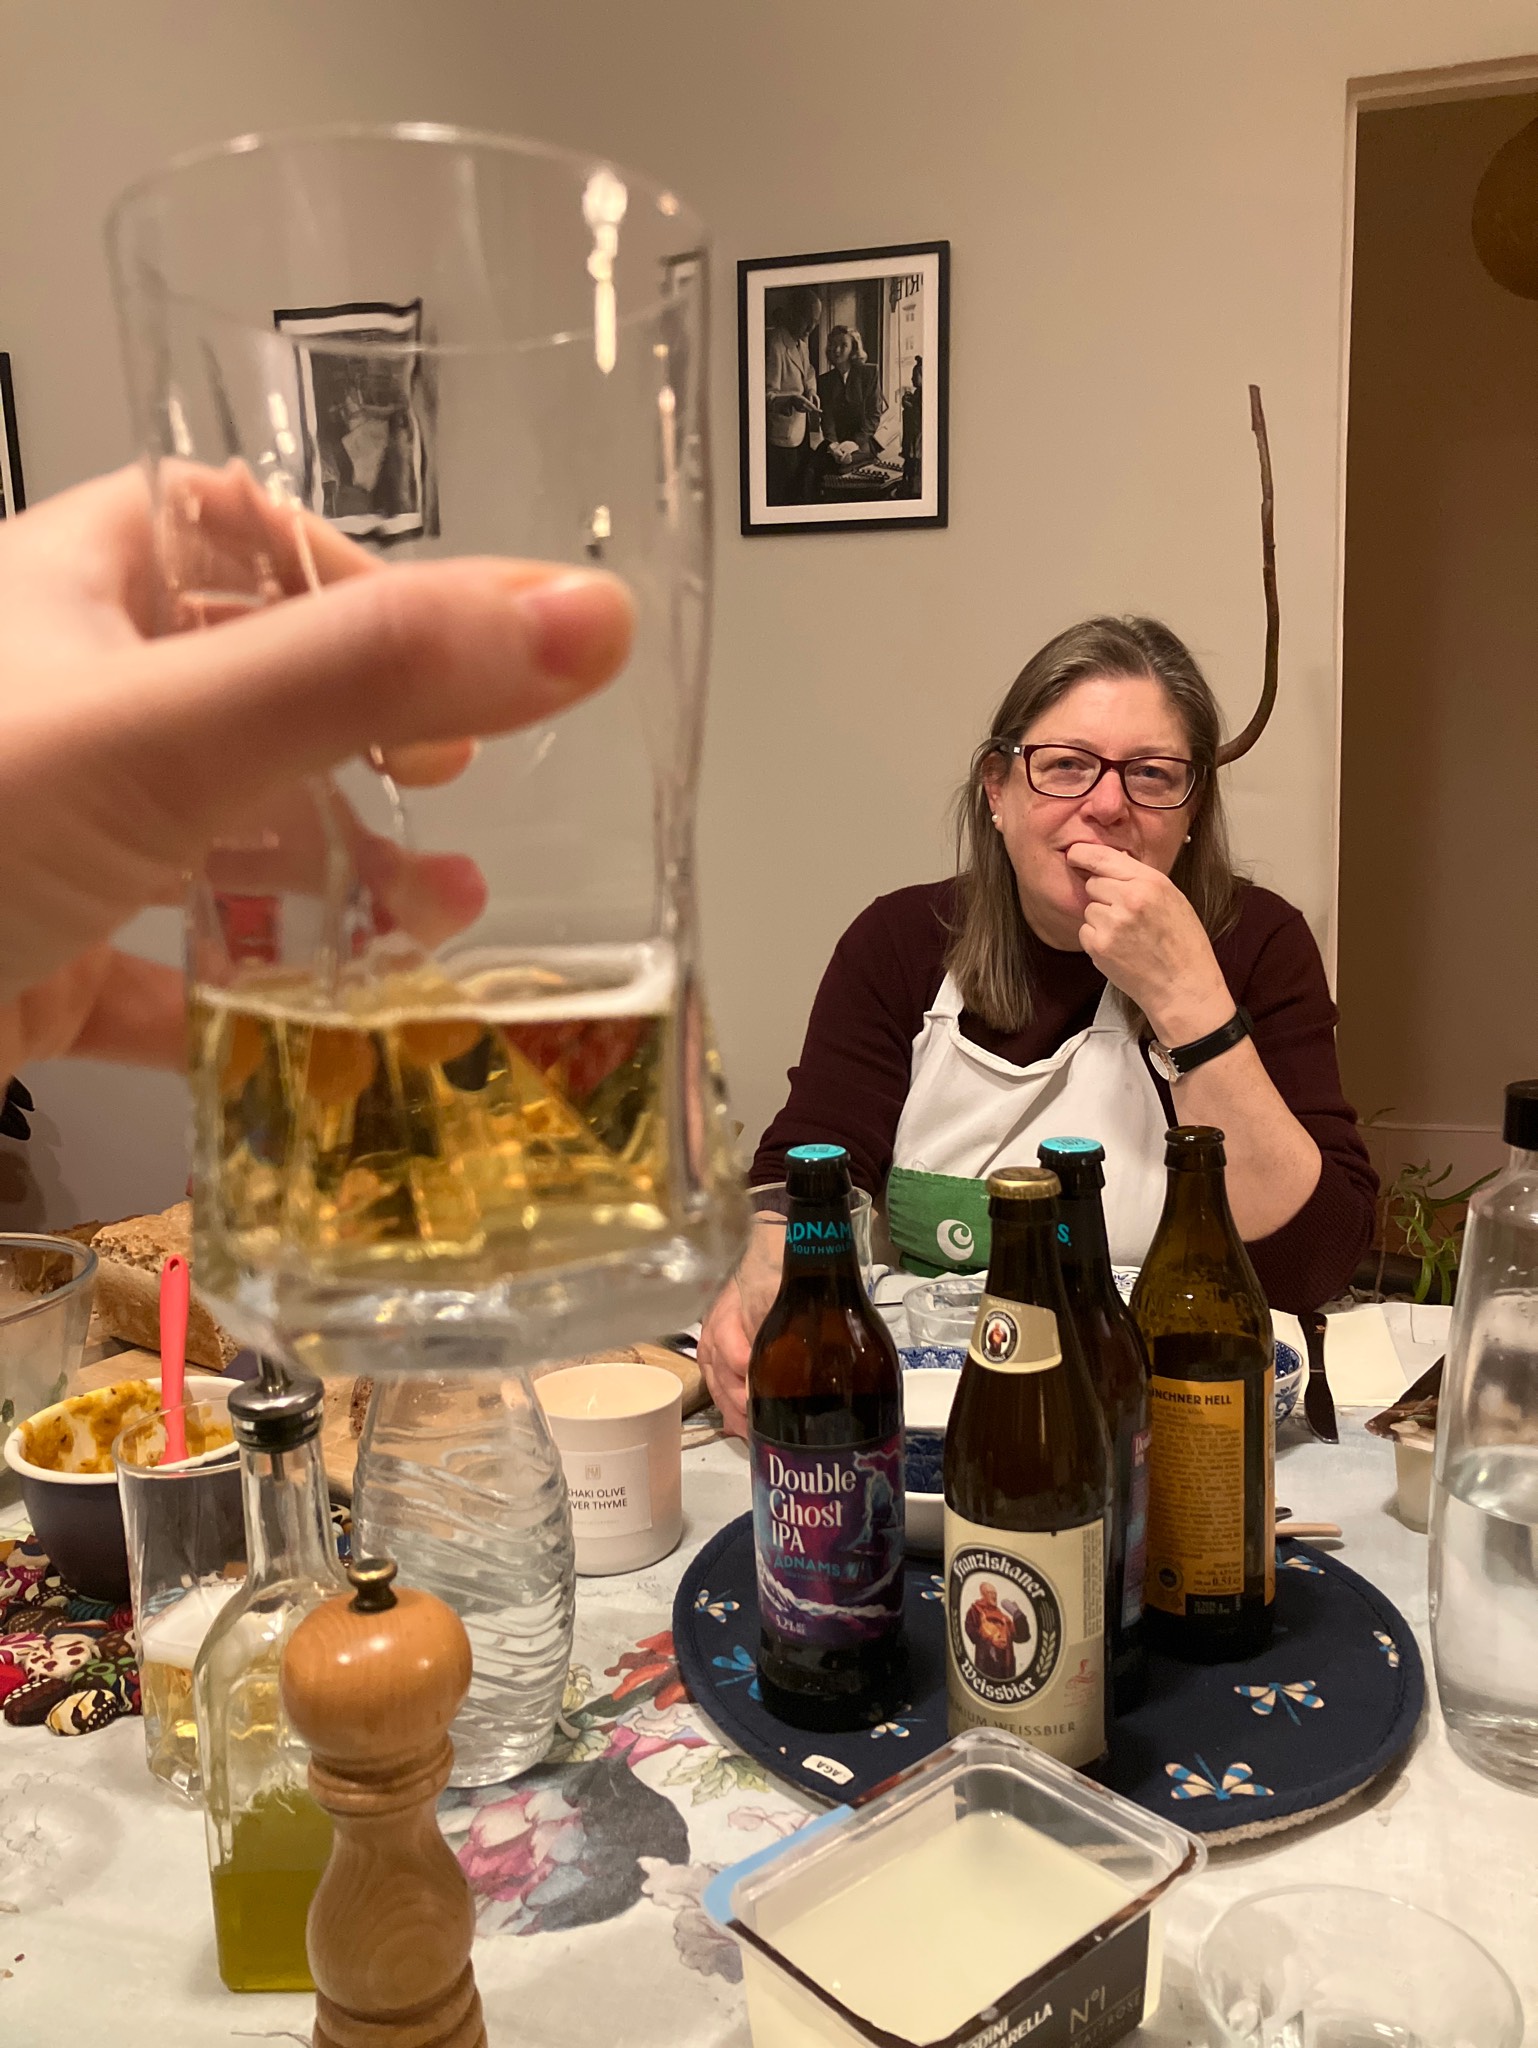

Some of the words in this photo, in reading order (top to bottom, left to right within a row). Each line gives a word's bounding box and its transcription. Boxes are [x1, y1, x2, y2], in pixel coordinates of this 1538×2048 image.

[1204, 1394, 1233, 1405] HELL
[769, 1453, 857, 1495] Double
[596, 1486, 626, 1498] OLIVE
[571, 1500, 590, 1510] VER
[593, 1498, 628, 1510] THYME
[769, 1488, 843, 1529] Ghost
[772, 1520, 805, 1554] IPA
[774, 1555, 841, 1578] ADNAMS
[953, 1552, 1046, 1599] Franziskaner
[994, 1720, 1076, 1737] WEISSBIER
